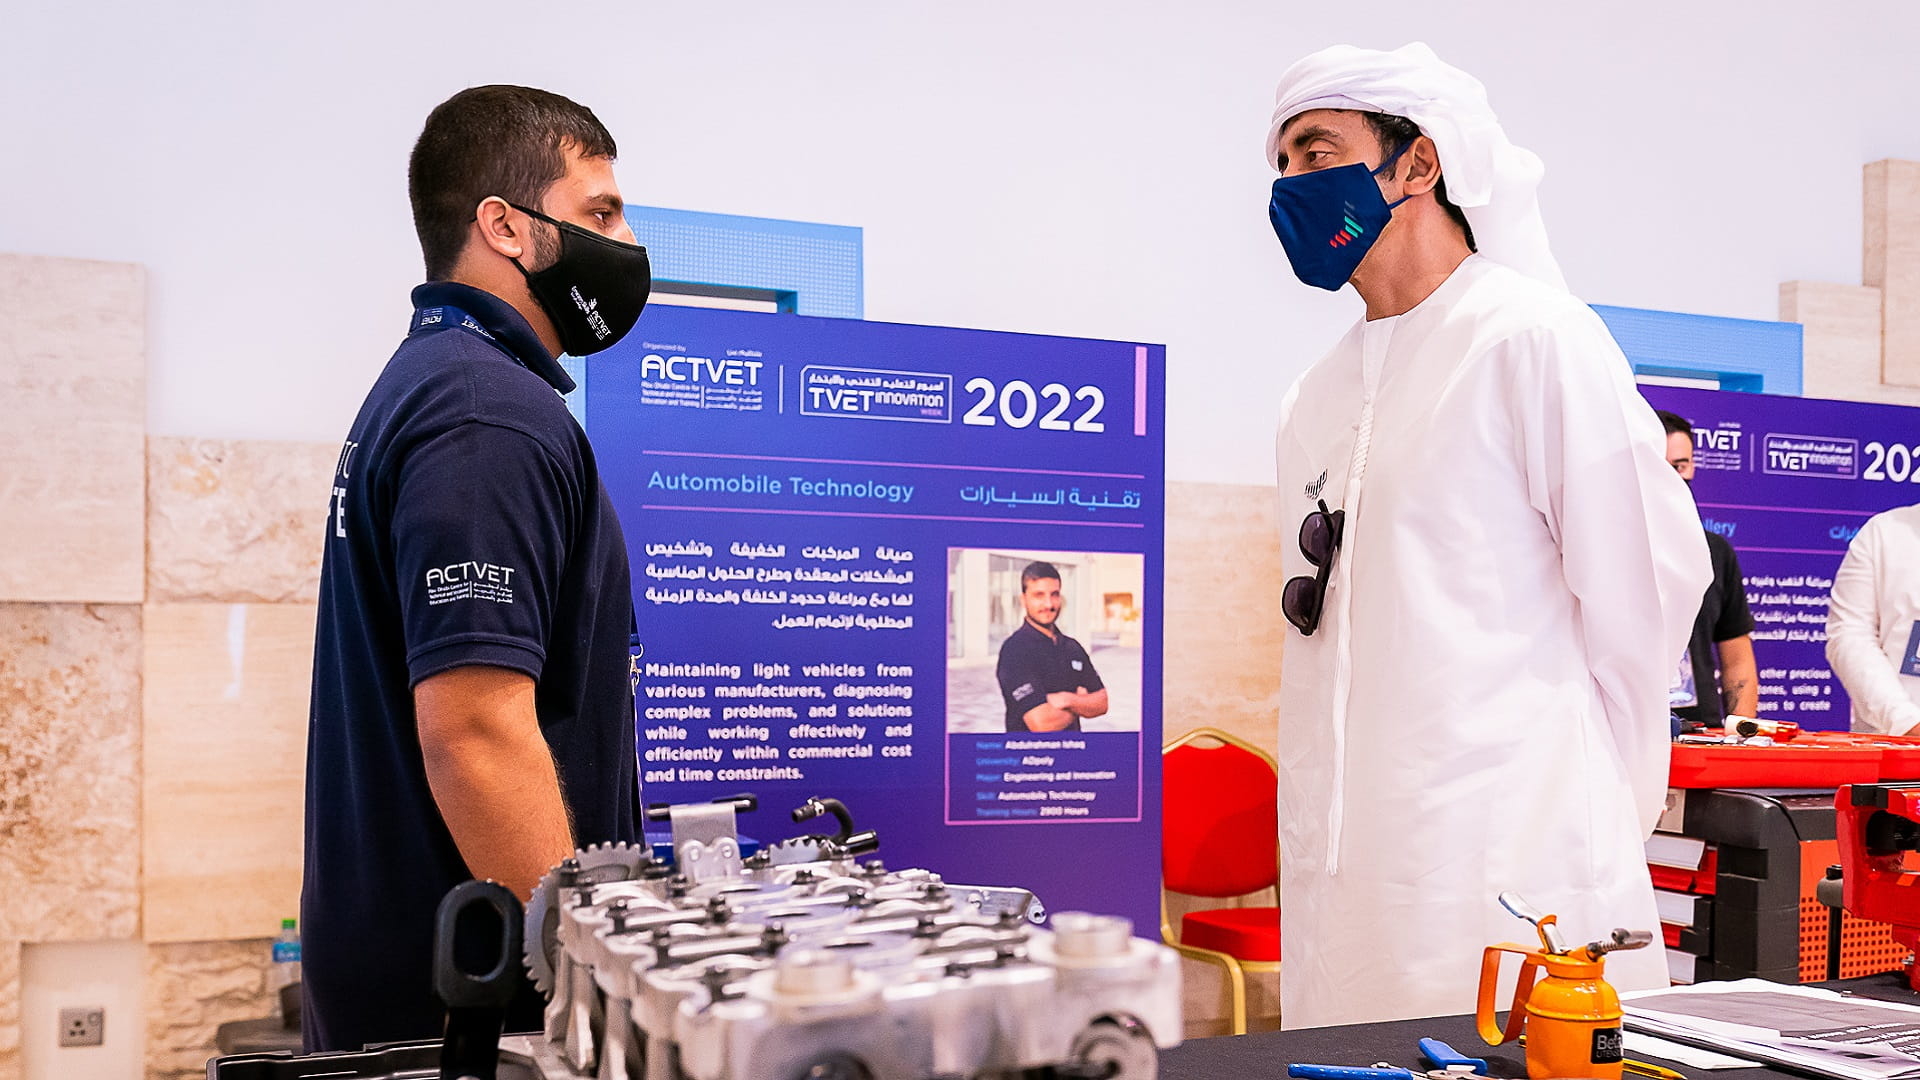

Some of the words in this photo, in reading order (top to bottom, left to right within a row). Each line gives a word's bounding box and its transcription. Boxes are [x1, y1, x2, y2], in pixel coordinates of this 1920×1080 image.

[641, 354, 764, 386] ACTVET
[808, 387, 875, 412] TVET
[963, 377, 1105, 433] 2022
[1768, 450, 1810, 471] TVET
[648, 471, 782, 494] Automobile
[789, 476, 914, 503] Technology
[960, 486, 1065, 508] السيارات
[1069, 488, 1141, 511] تقنية
[426, 561, 515, 588] ACTVET
[645, 662, 741, 680] Maintaining
[753, 662, 791, 680] light
[802, 663, 865, 677] vehicles
[877, 663, 913, 677] from
[1760, 668, 1787, 680] other
[1789, 667, 1831, 681] precious
[645, 684, 706, 698] various
[714, 683, 826, 699] manufacturers,
[833, 683, 913, 700] diagnosing
[1792, 683, 1819, 697] using
[645, 704, 711, 721] complex
[723, 704, 798, 721] problems,
[808, 704, 837, 718] and
[847, 703, 913, 718] solutions
[1783, 699, 1795, 712] to
[1800, 699, 1831, 711] create
[645, 726, 687, 740] while
[708, 724, 770, 742] working
[789, 724, 866, 740] effectively
[885, 723, 913, 737] and
[645, 746, 723, 763] efficiently
[732, 745, 779, 760] within
[788, 743, 873, 759] commercial
[881, 743, 913, 757] cost
[645, 768, 675, 783] and
[678, 767, 714, 782] time
[717, 765, 804, 781] constraints.
[998, 790, 1048, 801] Automobile
[1048, 790, 1097, 802] Technology
